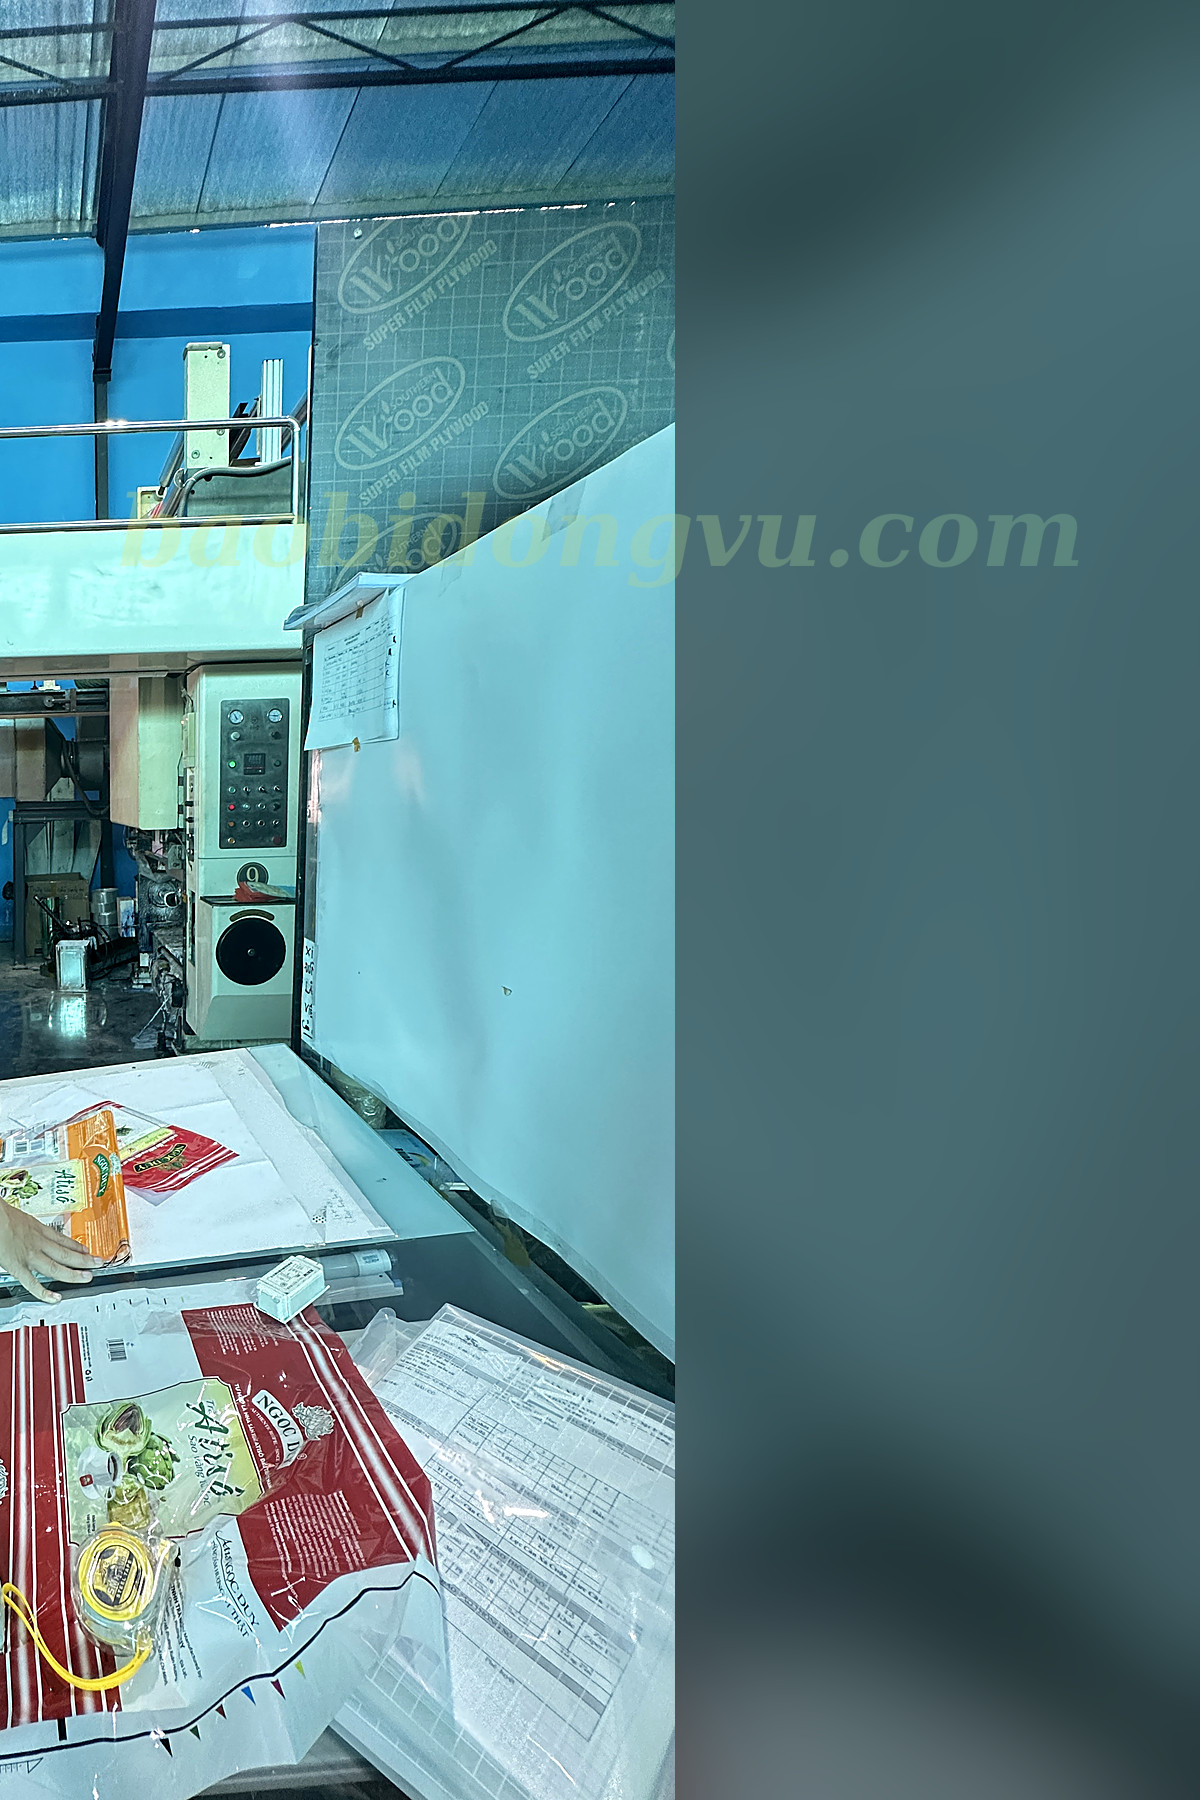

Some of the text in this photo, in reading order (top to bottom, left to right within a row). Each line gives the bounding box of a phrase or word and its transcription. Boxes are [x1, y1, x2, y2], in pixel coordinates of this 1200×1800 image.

[363, 239, 498, 351] SUPER FILM PLYWOOD
[527, 268, 667, 380] SUPER FILM PLYWOOD
[390, 372, 438, 411] SOUTHERN
[359, 401, 490, 506] SUPER FILM PLYWOOD
[246, 866, 259, 883] 9
[54, 1169, 76, 1205] Atisô
[256, 1395, 296, 1435] NGOC
[187, 1433, 199, 1453] Sao
[236, 1593, 260, 1628] DUY
